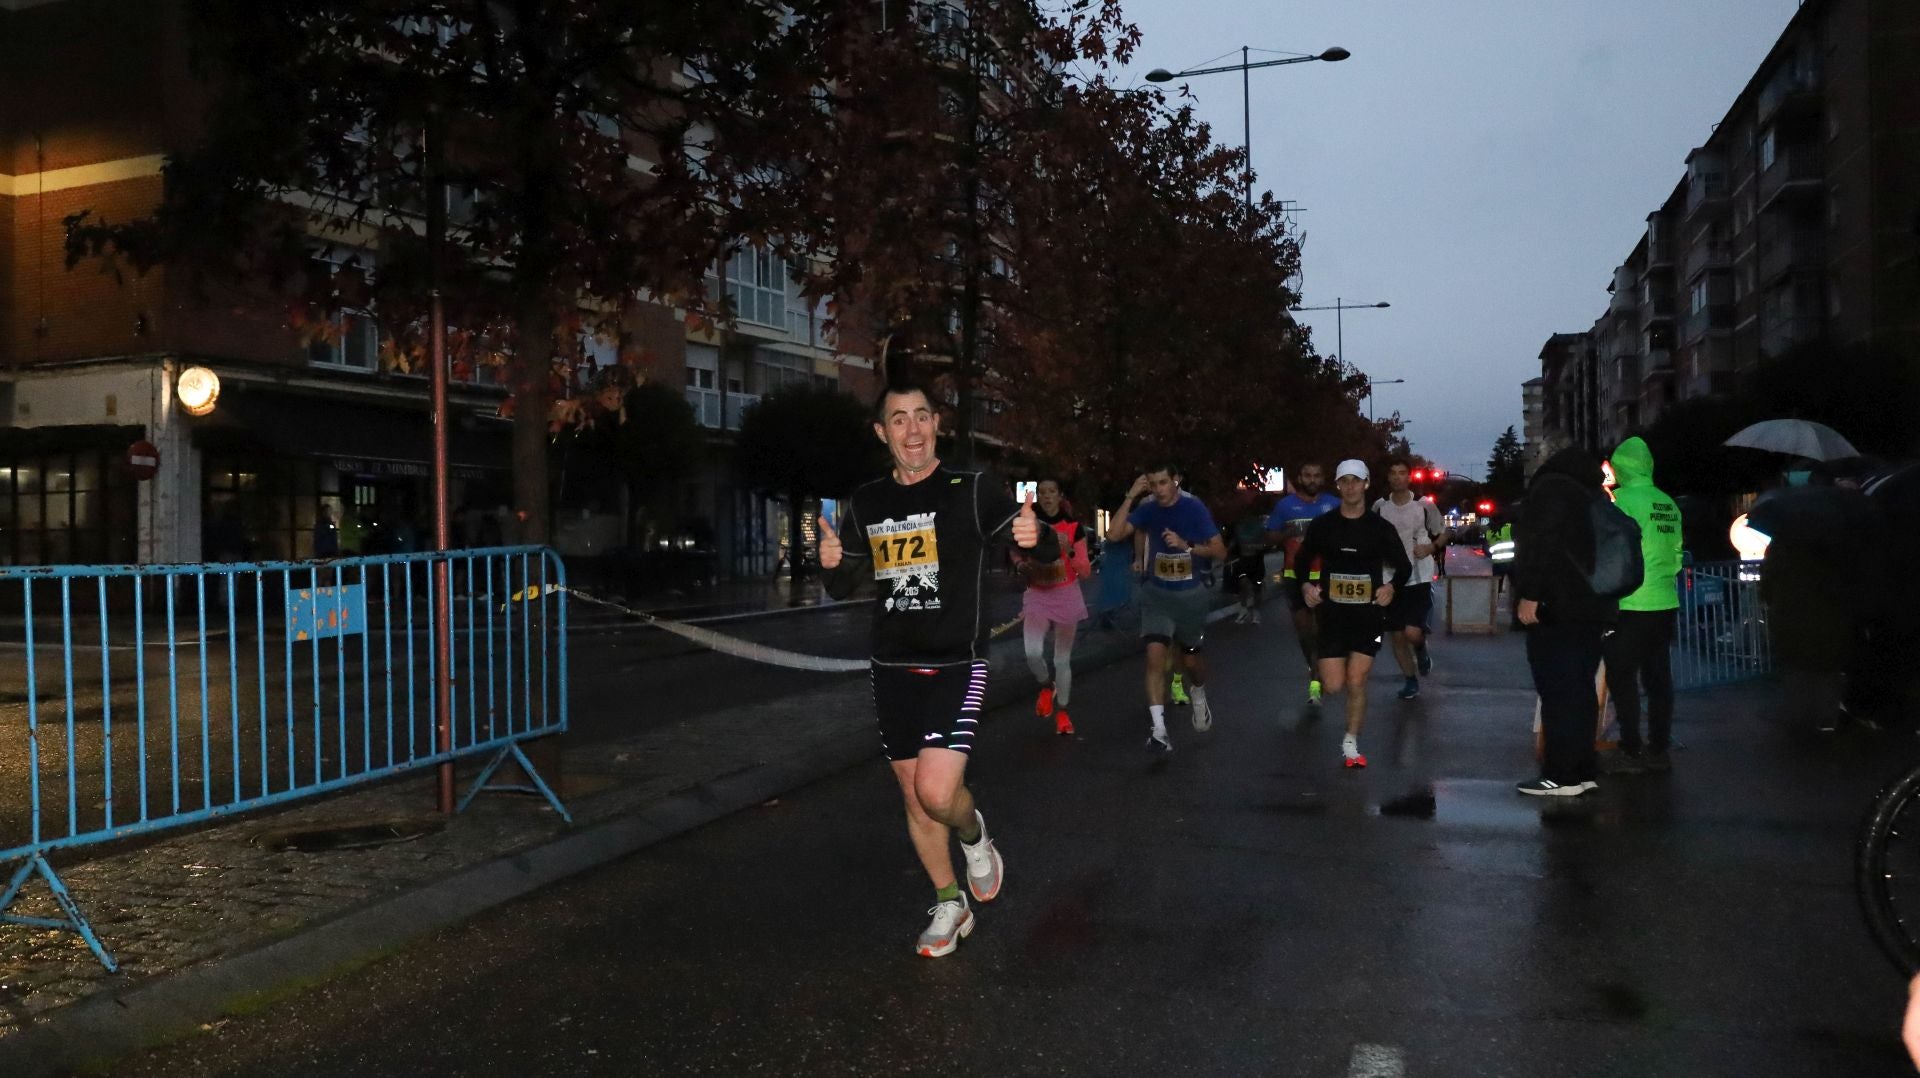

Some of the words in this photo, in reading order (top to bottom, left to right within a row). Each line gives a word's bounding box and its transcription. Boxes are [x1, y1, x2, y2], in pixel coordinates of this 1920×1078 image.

[880, 536, 926, 562] 172
[1160, 561, 1185, 573] 615
[1337, 583, 1365, 596] 185
